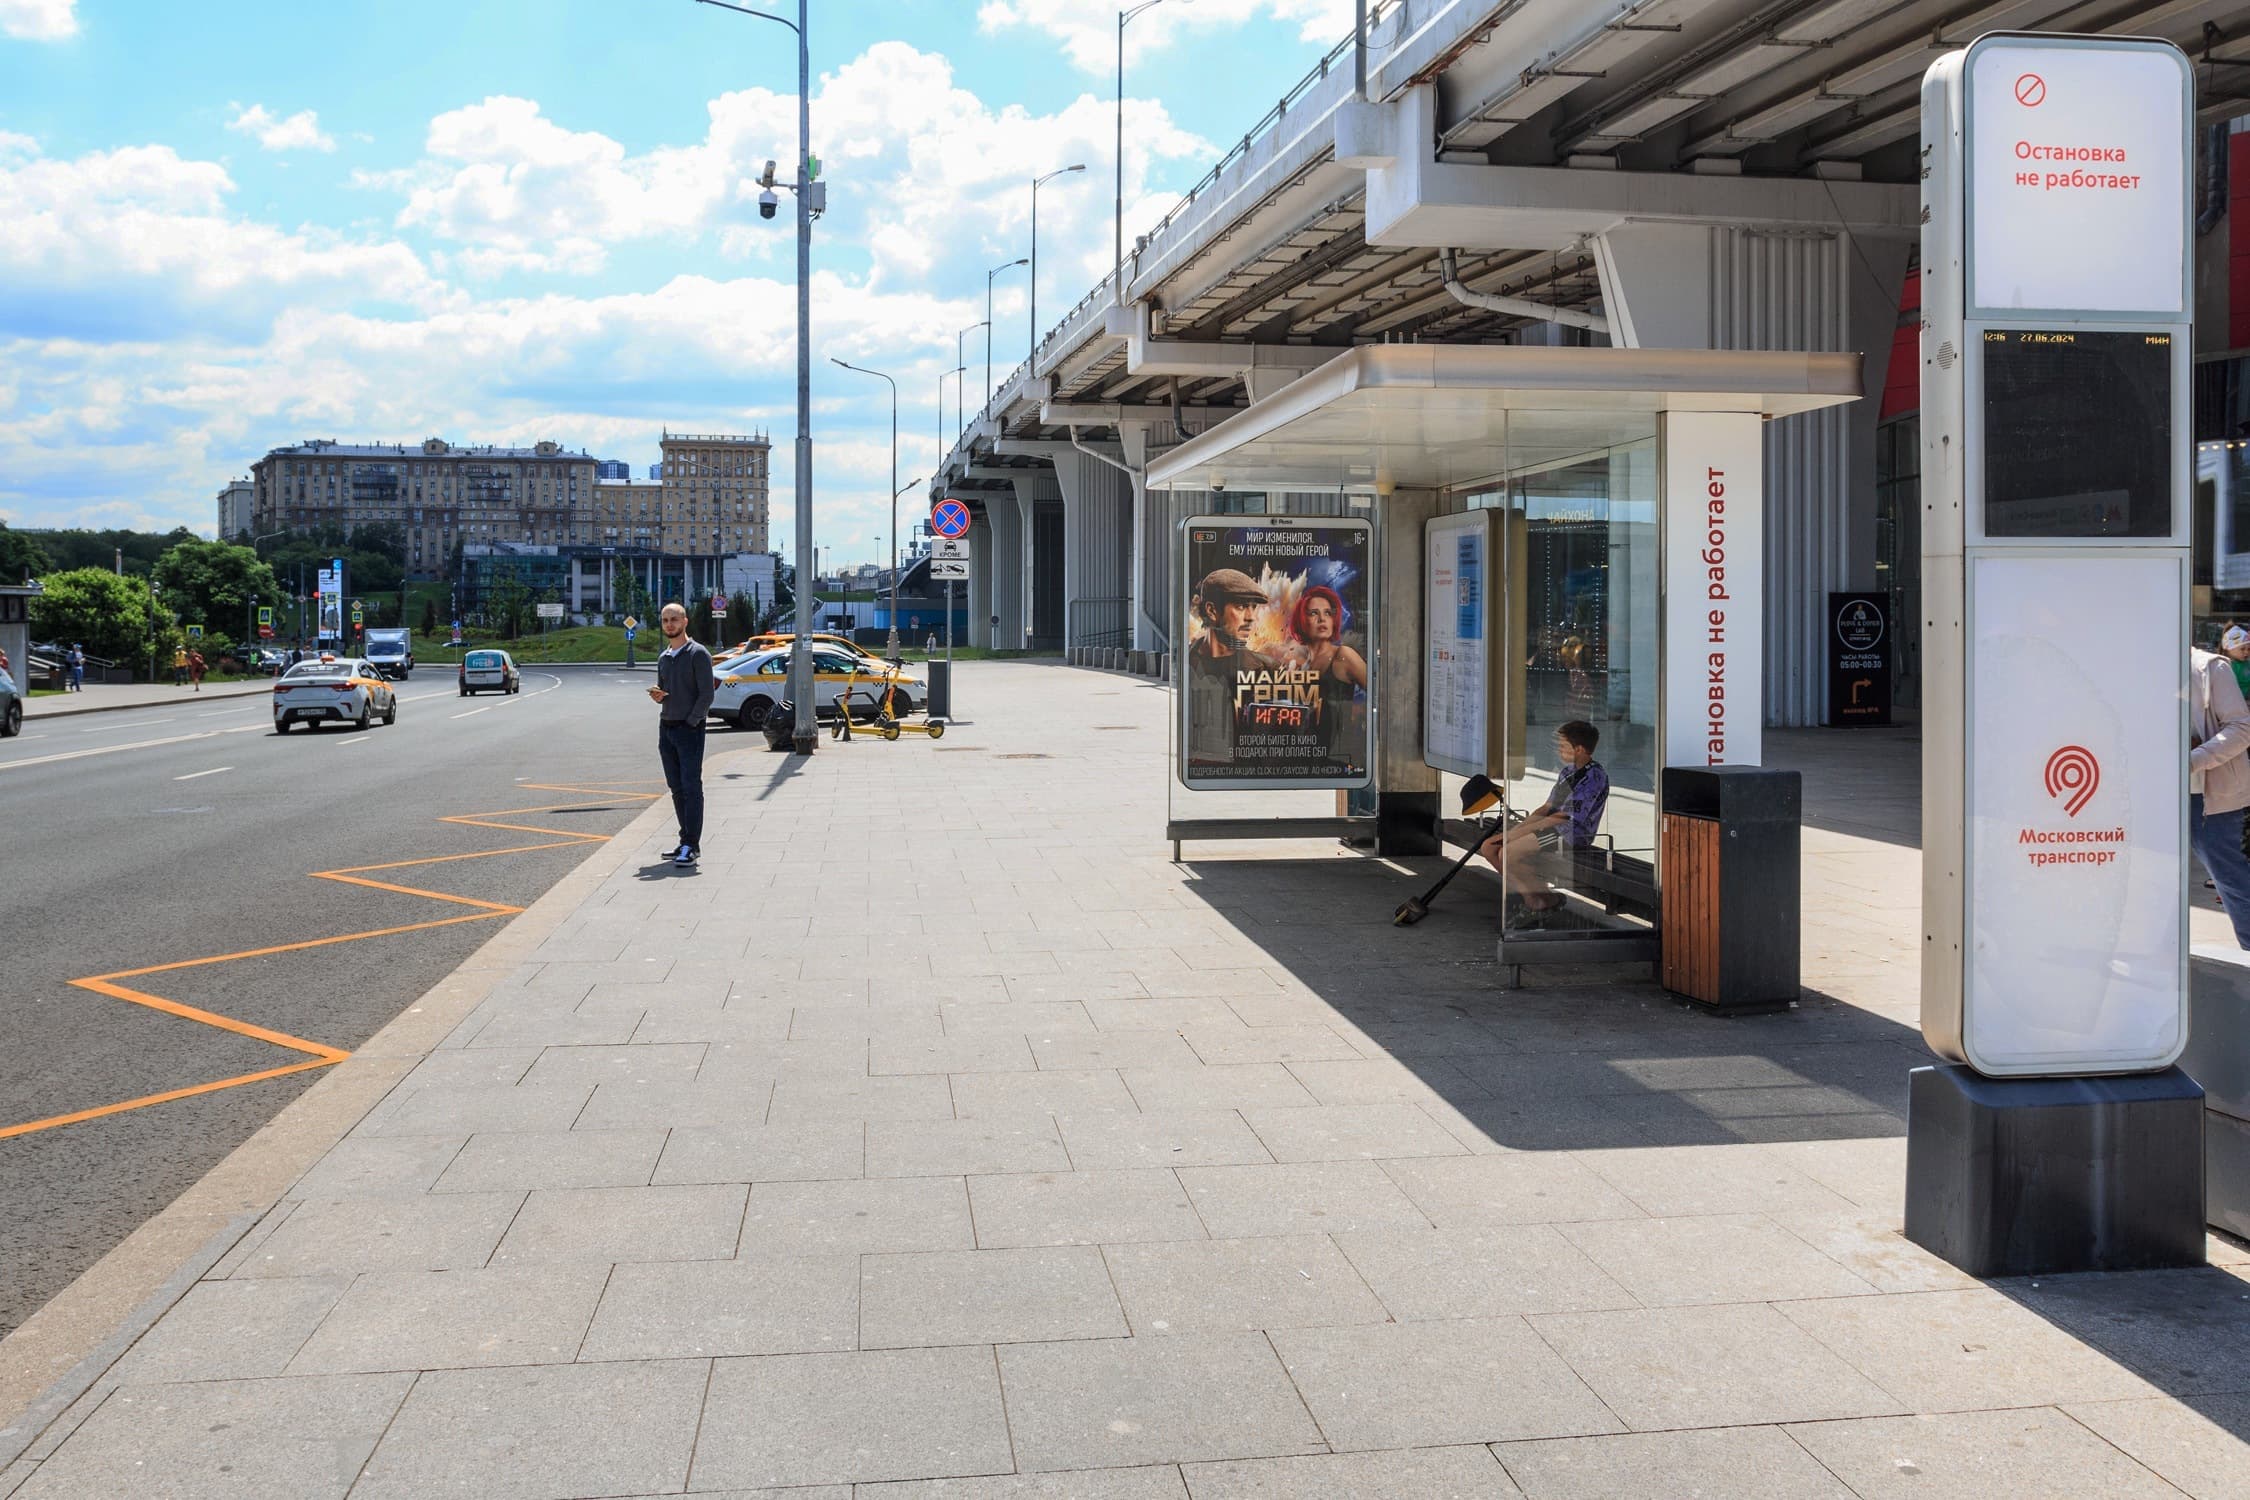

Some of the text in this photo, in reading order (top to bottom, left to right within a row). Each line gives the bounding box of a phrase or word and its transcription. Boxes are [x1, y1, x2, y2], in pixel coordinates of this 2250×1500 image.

[2015, 140, 2126, 162] Остановка
[2016, 169, 2141, 191] не работает
[1984, 332, 2075, 343] 12:16 27.06.2024
[1246, 532, 1264, 544] МИР
[1354, 532, 1366, 545] 16+
[1229, 543, 1329, 556] ЕМУ НУЖЕН НОВЫЙ ГЕРОЙ
[1702, 466, 1730, 767] тановка не работает
[1236, 666, 1320, 684] МАЙОР
[1235, 684, 1322, 708] ГРОМ
[1239, 734, 1317, 746] ВТОРОЙ БИЛЕТ В КИНО
[1228, 746, 1327, 758] В ПОДАРОК ПРИ ОПЛАТЕ СБП
[2018, 826, 2125, 844] Московский
[2028, 850, 2117, 867] транспорт
